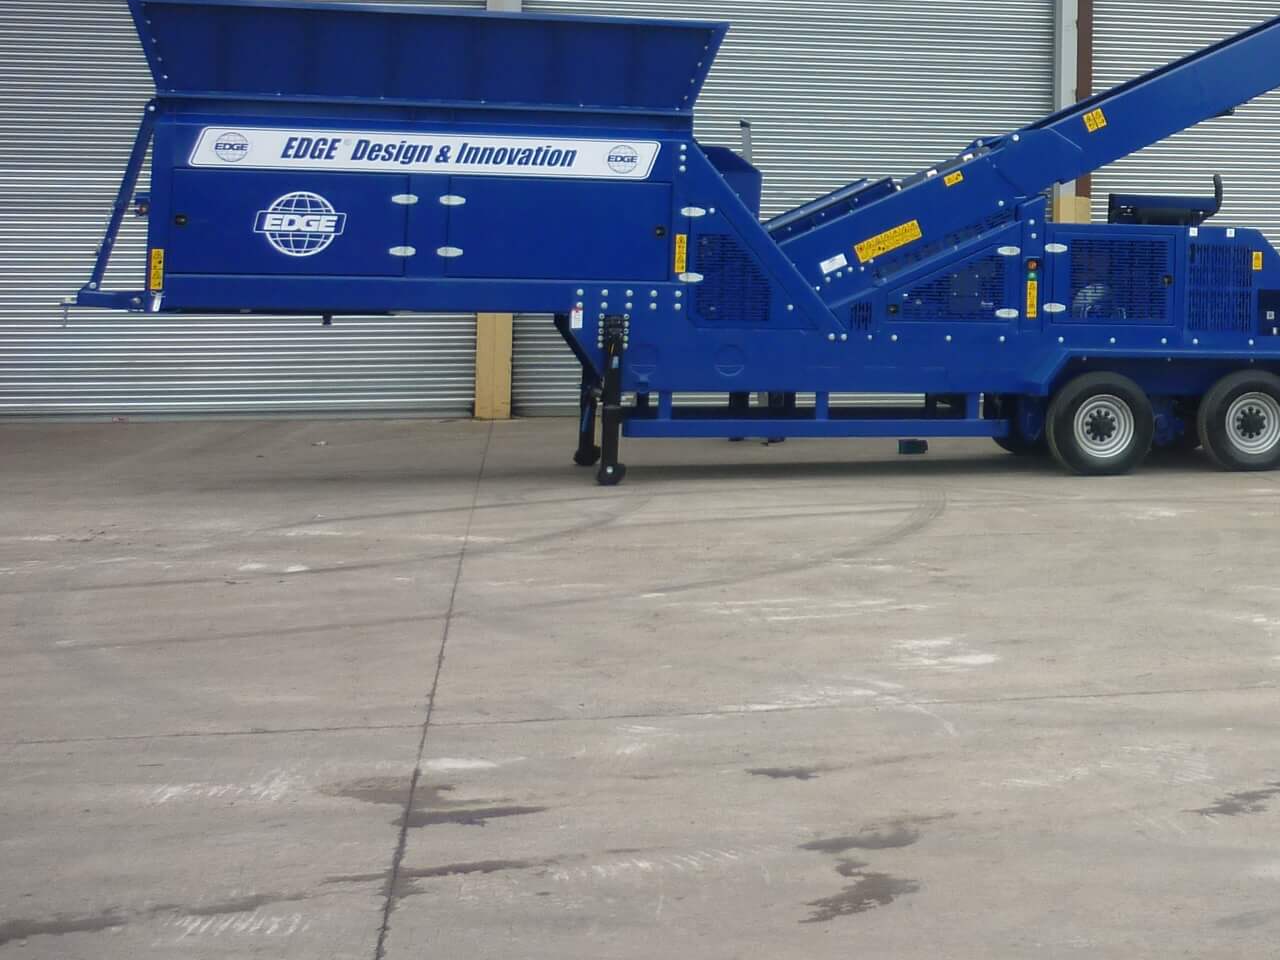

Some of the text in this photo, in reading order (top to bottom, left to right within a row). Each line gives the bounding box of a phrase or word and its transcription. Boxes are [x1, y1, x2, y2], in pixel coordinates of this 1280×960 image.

[214, 142, 249, 151] EDGE
[280, 136, 578, 168] EDGE Design & Innovation
[607, 153, 640, 164] EDGE
[263, 213, 338, 233] EDGE
